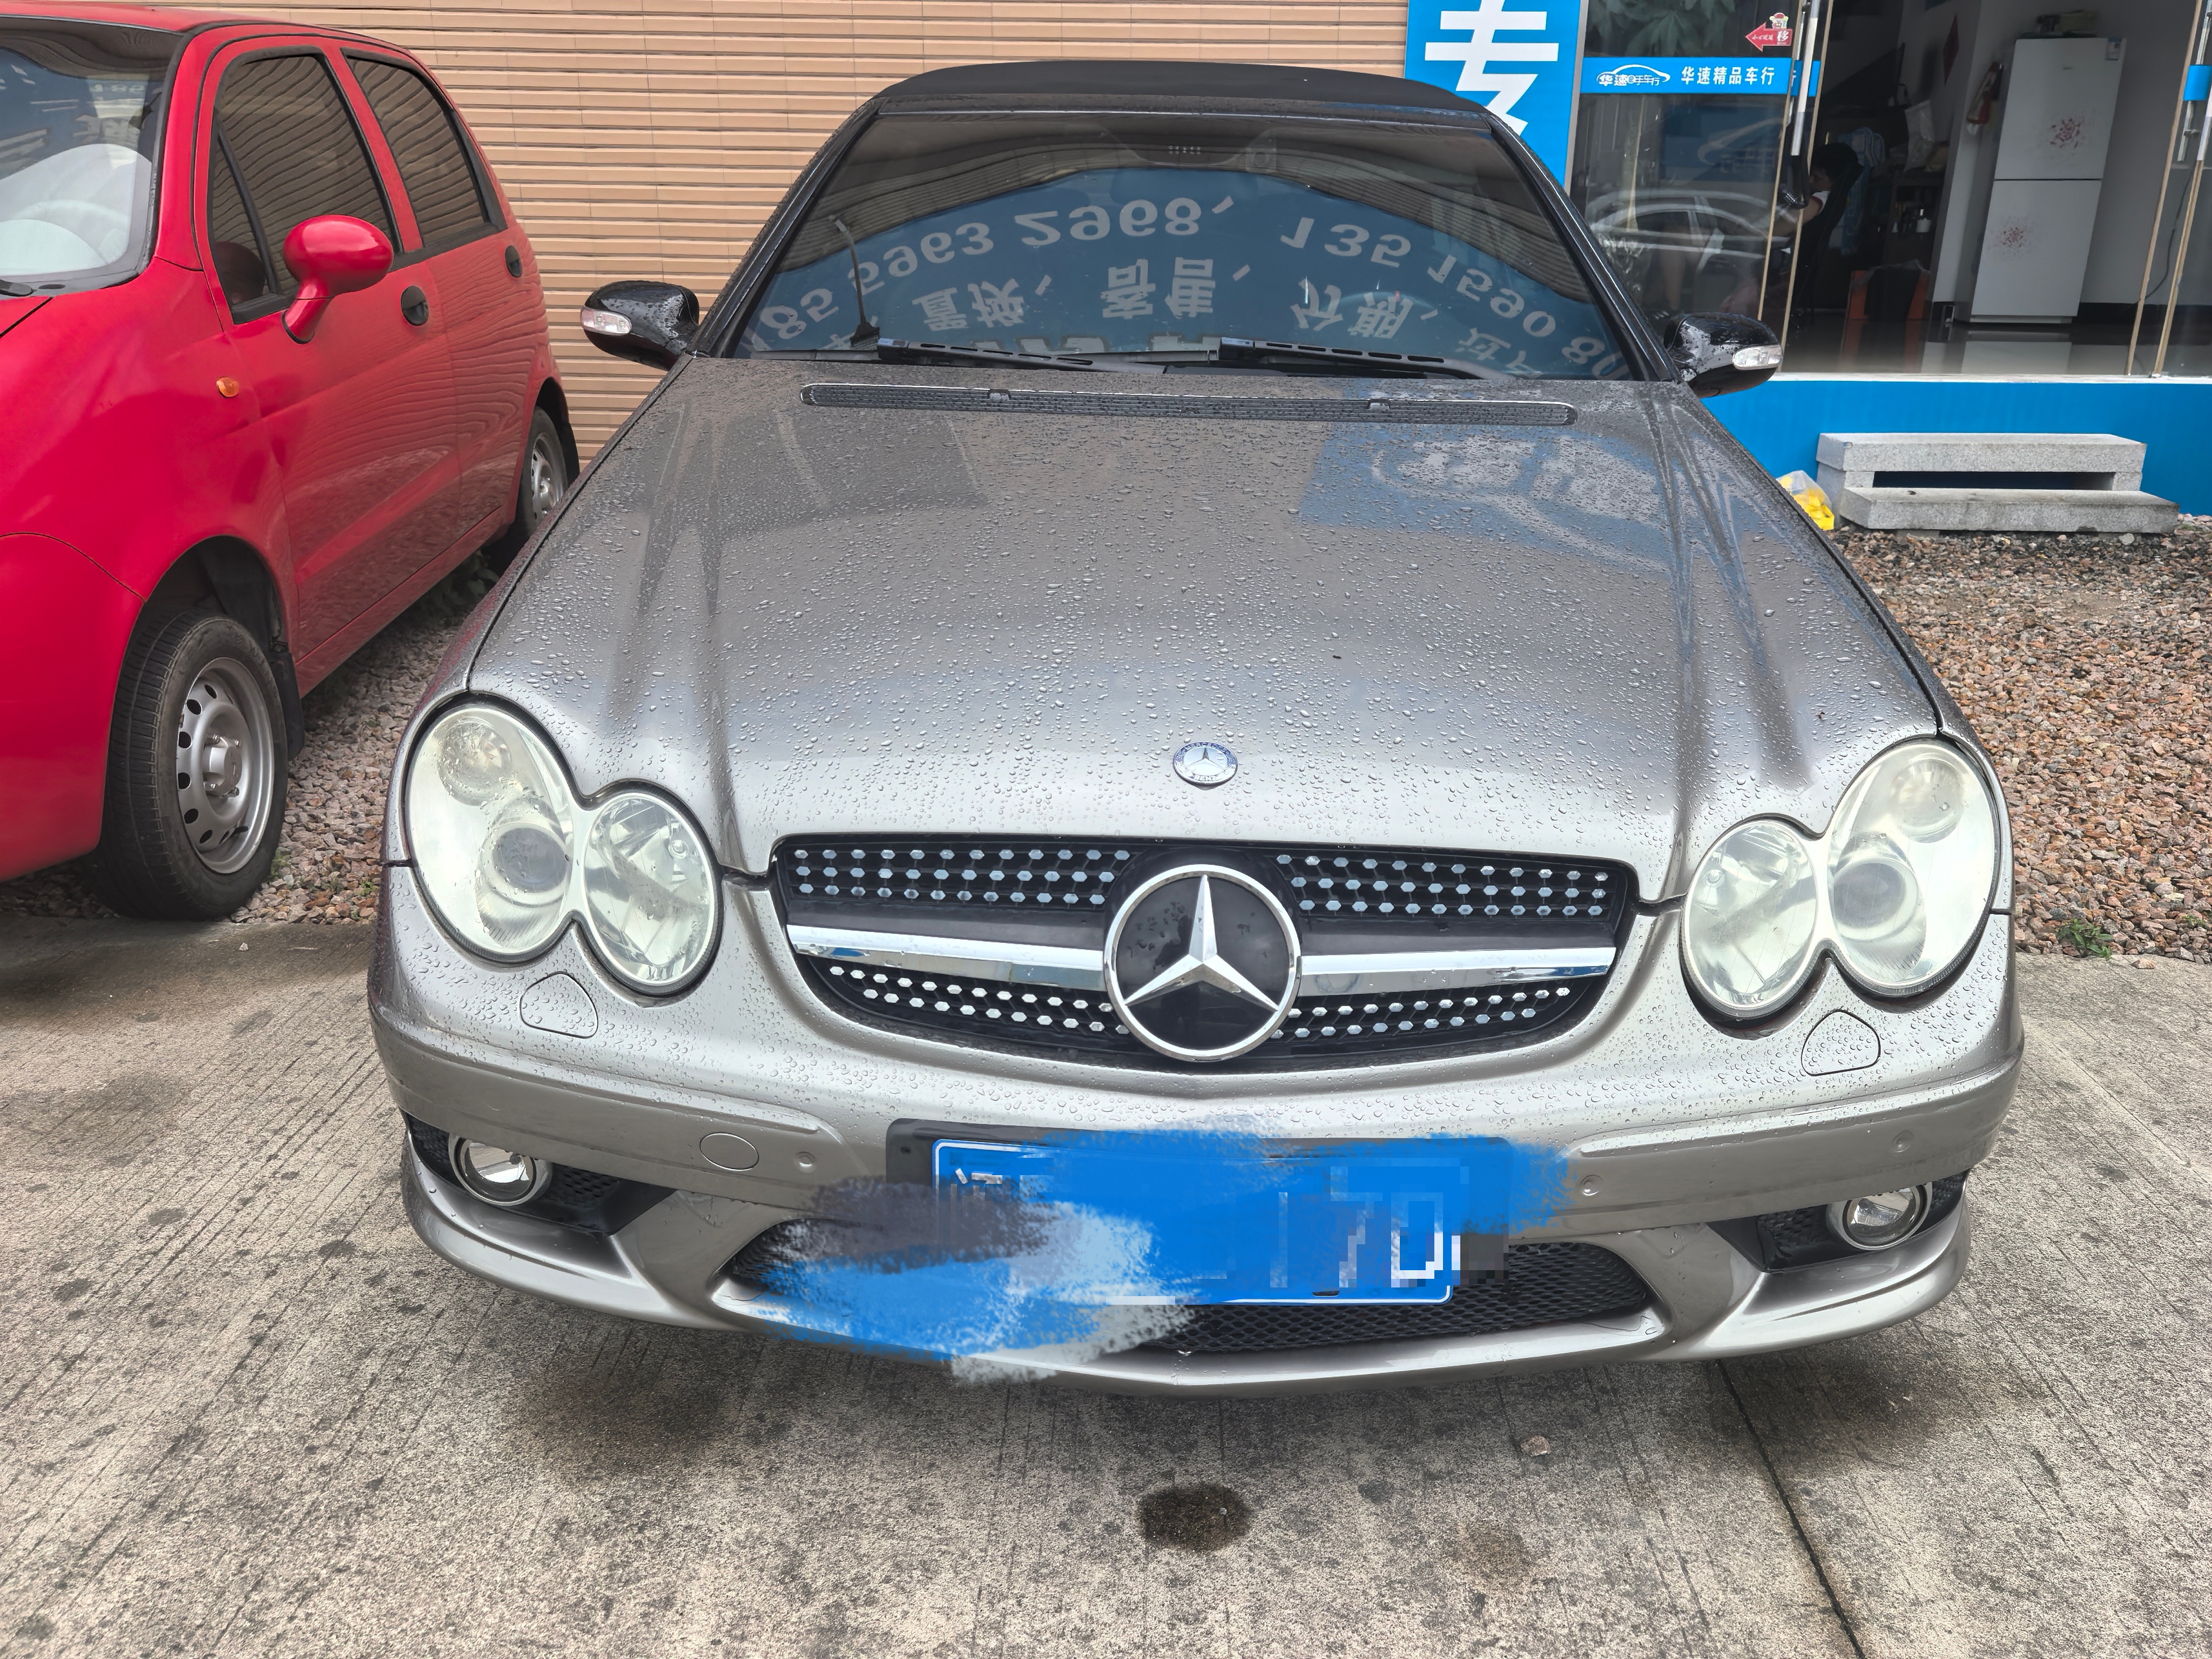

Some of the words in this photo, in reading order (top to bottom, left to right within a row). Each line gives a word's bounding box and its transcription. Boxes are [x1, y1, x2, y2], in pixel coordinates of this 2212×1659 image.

[1681, 66, 1775, 85] 华速精品车行
